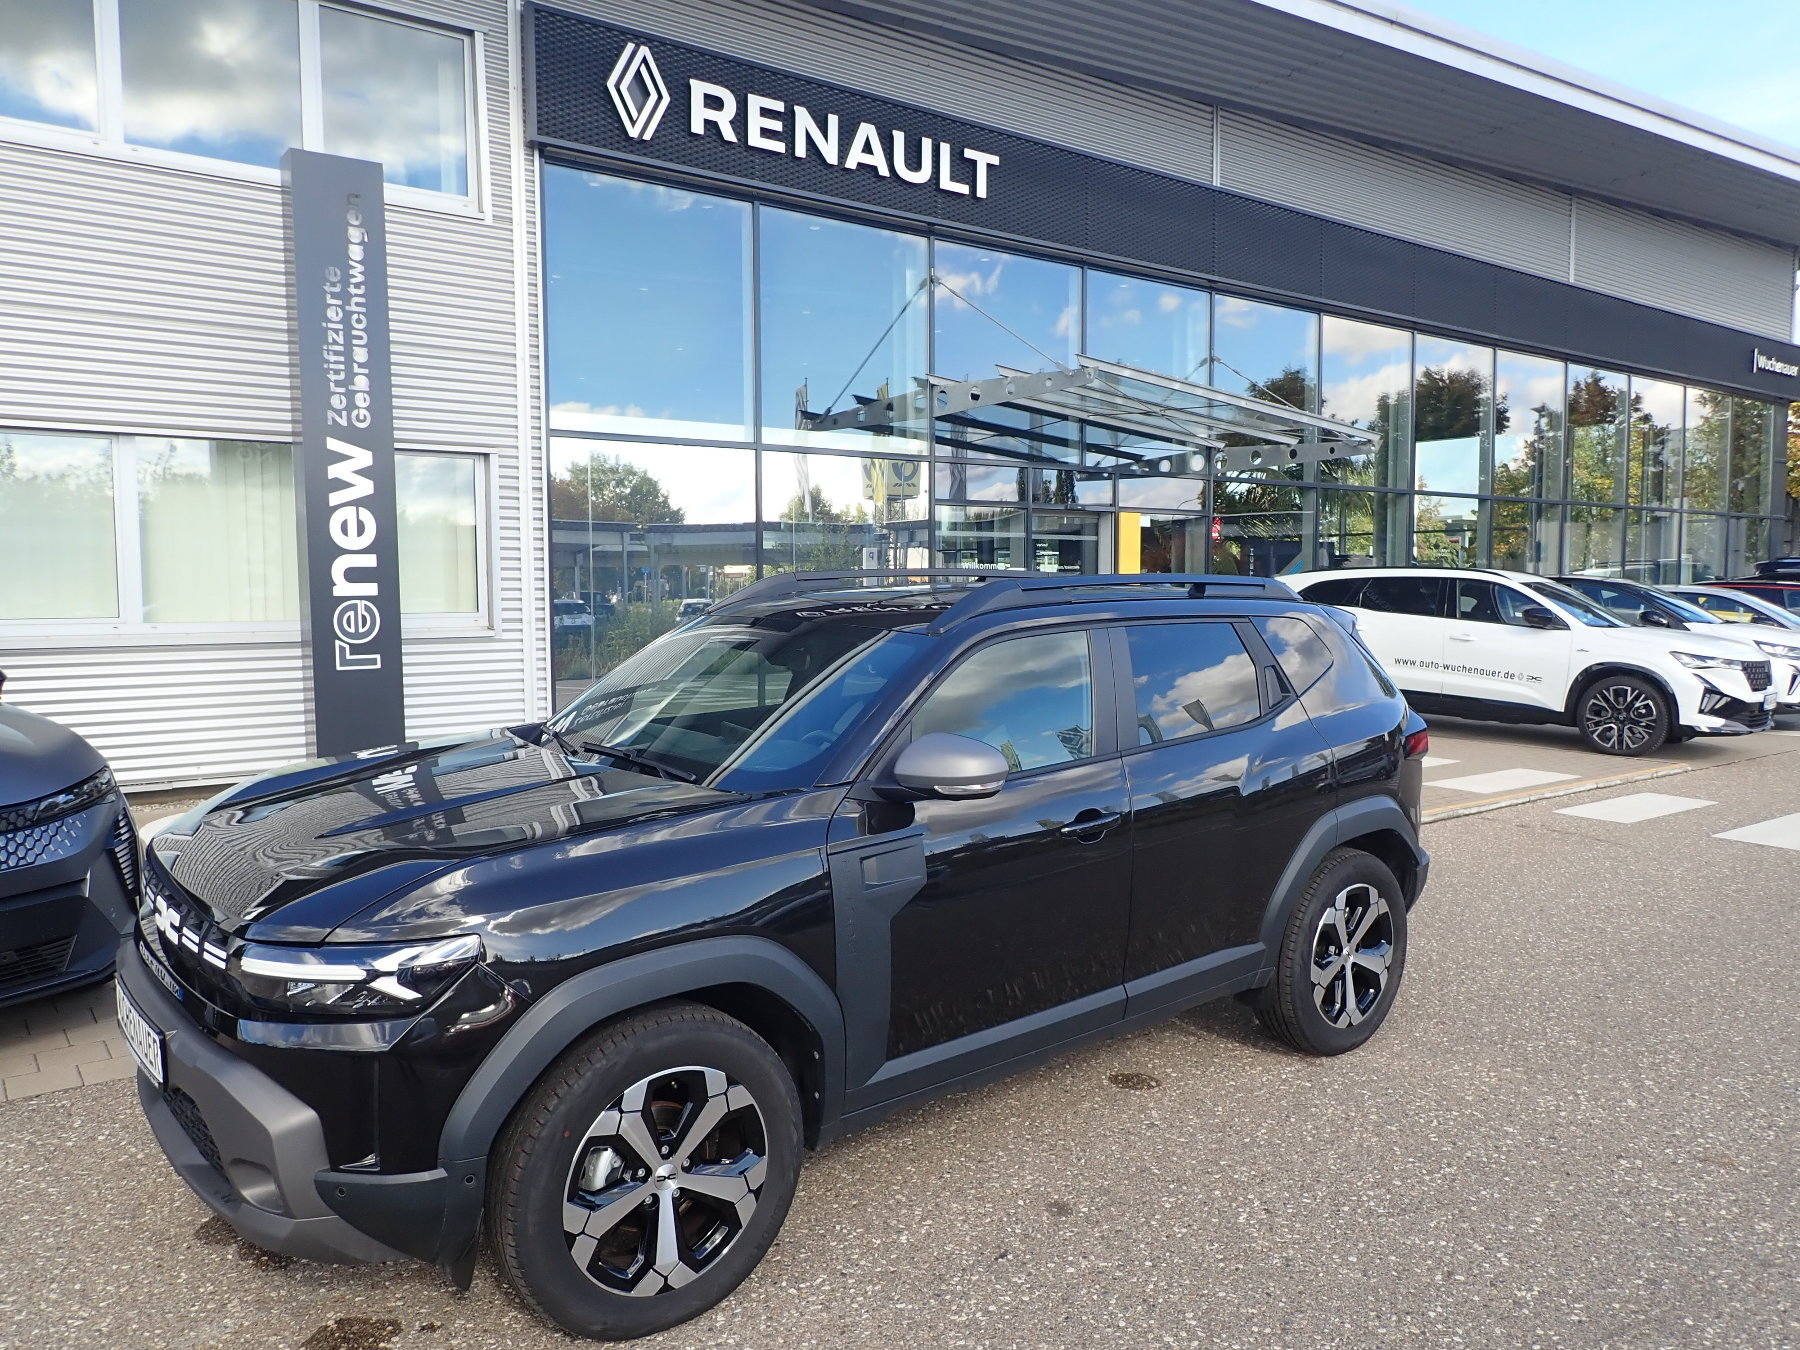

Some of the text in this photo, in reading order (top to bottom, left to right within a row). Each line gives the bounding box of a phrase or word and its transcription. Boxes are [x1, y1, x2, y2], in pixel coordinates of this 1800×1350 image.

[689, 78, 1000, 198] RENAULT
[322, 266, 349, 427] Zertifizierte
[345, 192, 372, 429] Gebrauchtwagen
[326, 436, 382, 671] renew
[1394, 656, 1516, 680] www.auto-wuchenauer.de
